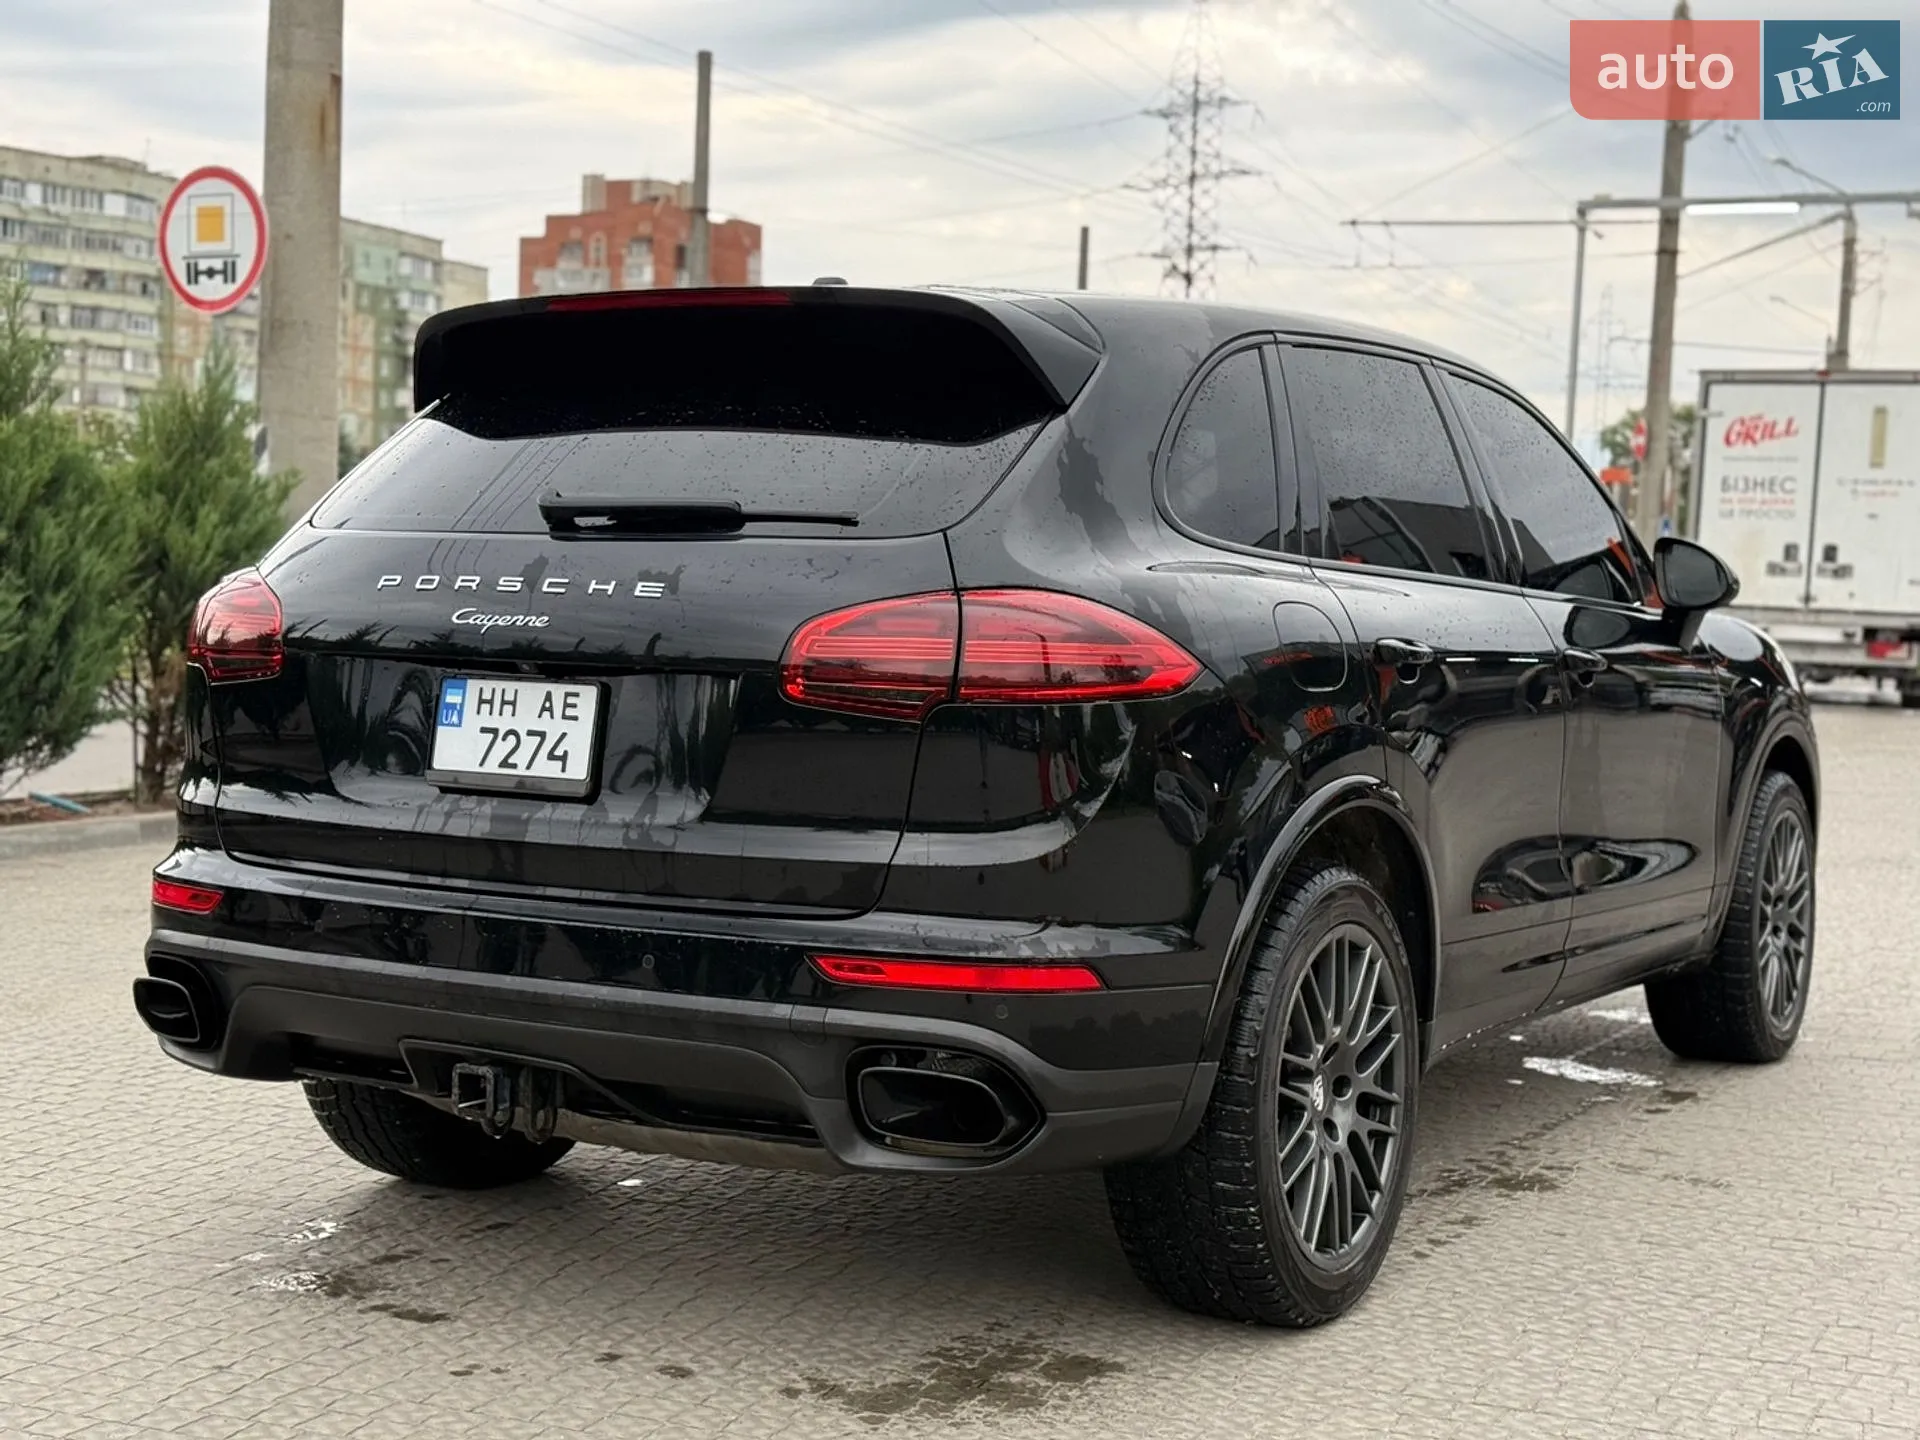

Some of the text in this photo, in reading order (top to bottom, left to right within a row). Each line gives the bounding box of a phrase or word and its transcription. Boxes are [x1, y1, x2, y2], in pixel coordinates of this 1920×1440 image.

[1723, 414, 1799, 448] GRILL
[1720, 475, 1797, 494] БІЗНЕС
[377, 575, 665, 598] PORSCHE
[451, 608, 550, 634] Cayenne
[476, 687, 580, 721] HH AE
[478, 726, 568, 773] 7274
